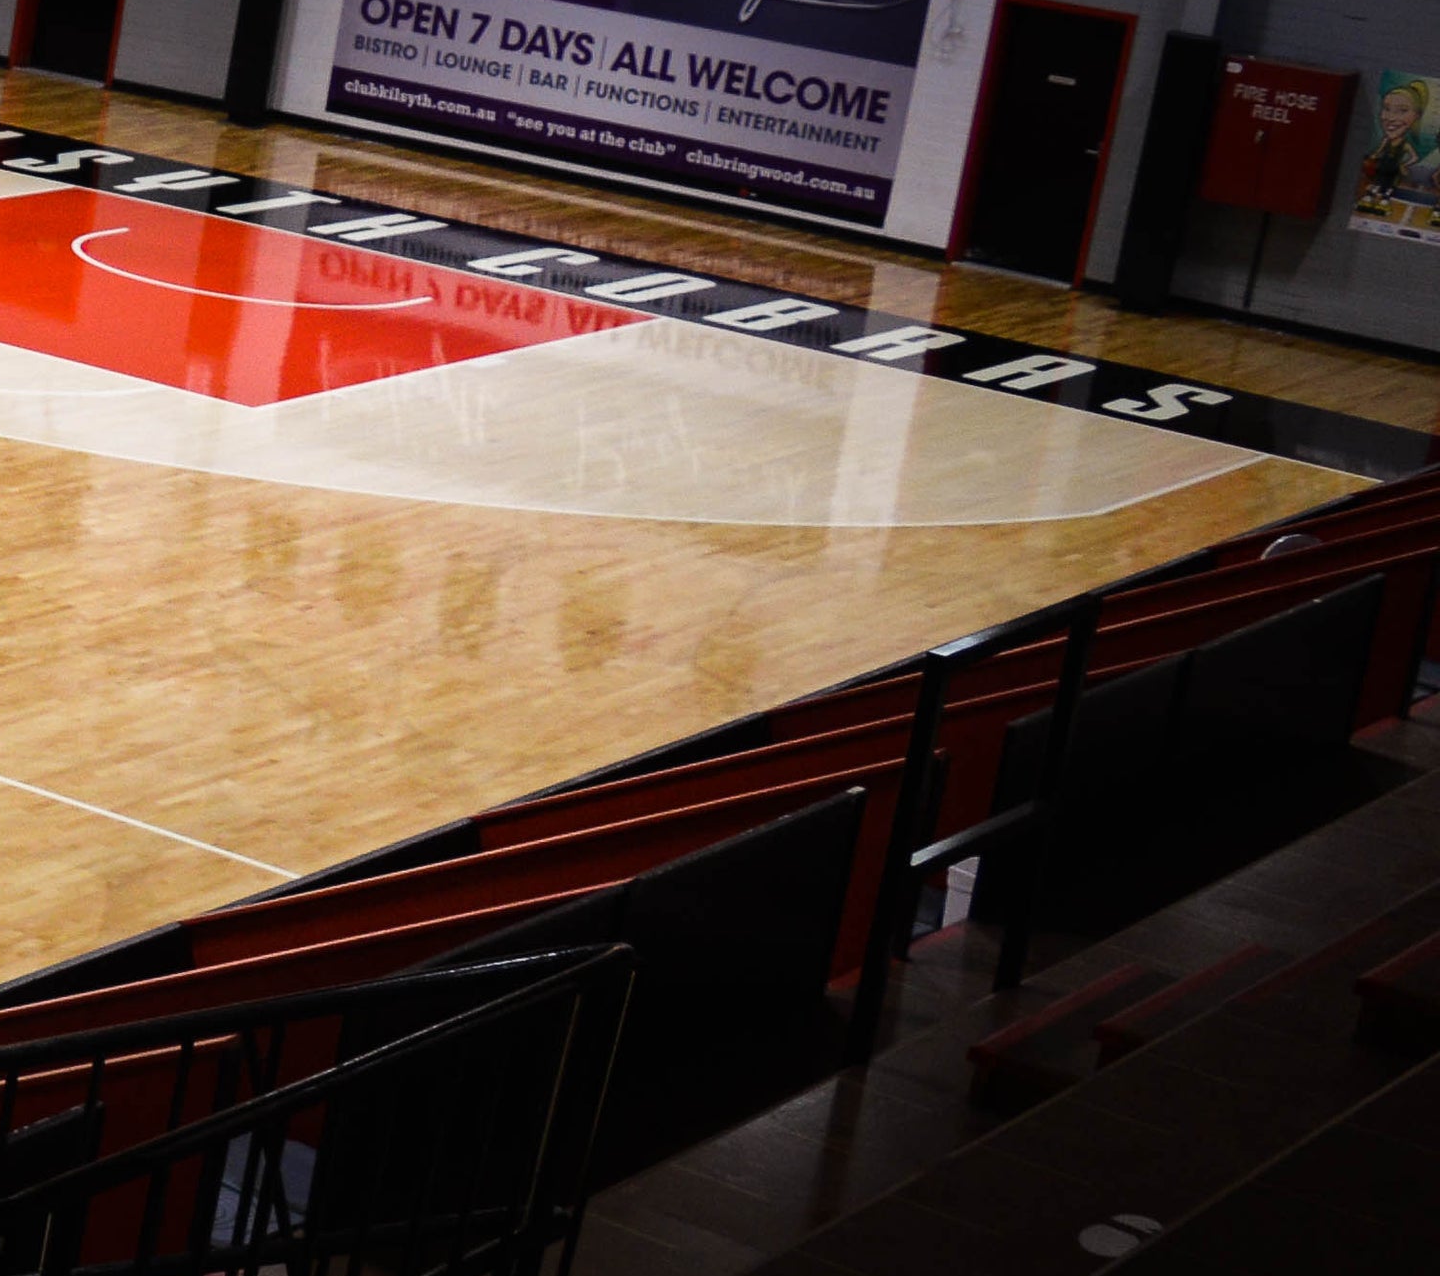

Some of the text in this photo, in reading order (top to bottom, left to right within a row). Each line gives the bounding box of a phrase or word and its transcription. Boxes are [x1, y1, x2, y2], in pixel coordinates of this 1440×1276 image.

[353, 33, 881, 155] BISTRO LOUNGE BAR FUNCTIONS ENTERTAINMENT
[468, 13, 492, 44] 7
[499, 18, 596, 67] DAYS
[610, 41, 676, 83] ALL
[688, 53, 893, 124] WELCOME
[1232, 82, 1320, 113] FIRE HOSE
[1250, 103, 1293, 126] REEL
[343, 78, 498, 124] clubkilsyth.com.au
[545, 120, 578, 140] you
[578, 127, 598, 143] at
[598, 130, 627, 150] the
[685, 148, 877, 202] clubringwood.com.au
[465, 245, 1236, 423] COBRAS
